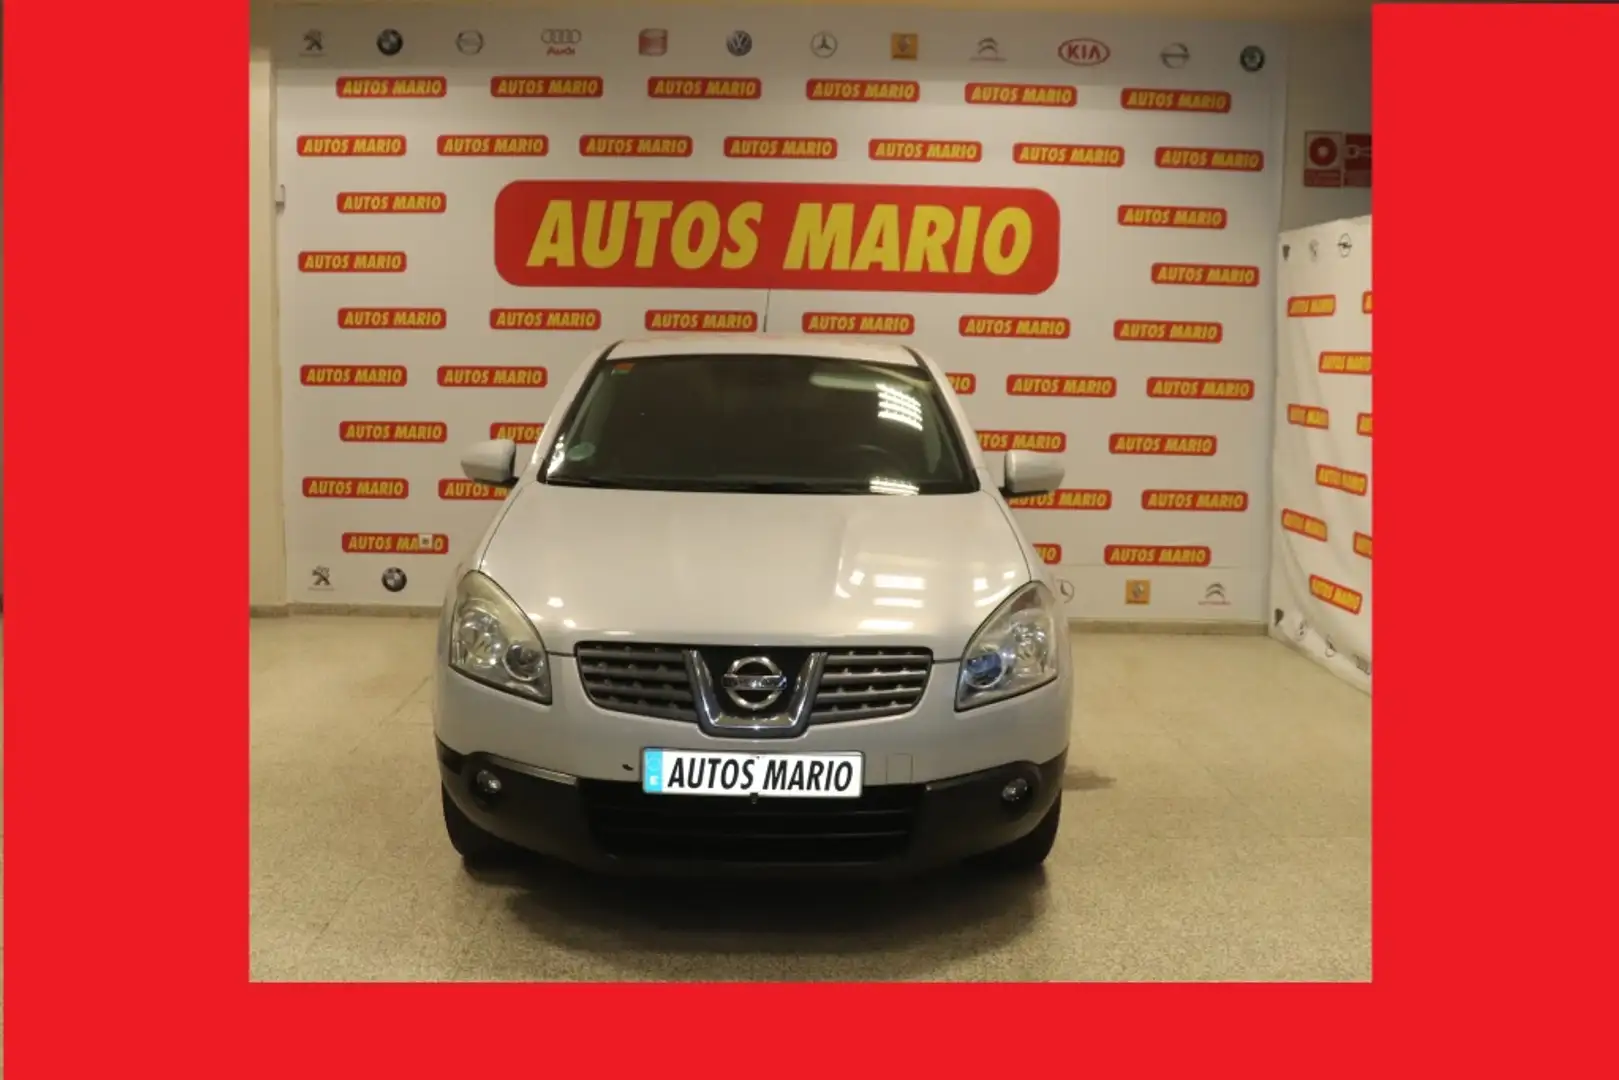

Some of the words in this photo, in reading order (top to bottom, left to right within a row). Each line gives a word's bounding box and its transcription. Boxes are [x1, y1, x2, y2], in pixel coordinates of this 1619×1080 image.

[1066, 43, 1101, 60] KIA
[343, 80, 389, 95] AUTOS
[391, 80, 442, 95] MARIO
[497, 79, 546, 95] AUTOS
[548, 80, 598, 95] MARIO
[654, 80, 702, 95] AUTOS
[705, 81, 756, 96] MARIO
[814, 82, 862, 97] AUTOS
[864, 83, 916, 99] MARIO
[971, 86, 1019, 101] AUTOS
[1021, 88, 1073, 103] MARIO
[1126, 91, 1174, 107] AUTOS
[1176, 93, 1226, 109] MARIO
[303, 138, 350, 153] AUTOS
[352, 138, 402, 153] MARIO
[443, 138, 491, 153] AUTOS
[493, 138, 544, 153] MARIO
[586, 138, 635, 153] AUTOS
[637, 139, 689, 153] MARIO
[731, 140, 779, 155] AUTOS
[781, 141, 833, 156] MARIO
[876, 142, 923, 158] AUTOS
[925, 144, 978, 159] MARIO
[1019, 146, 1066, 162] AUTOS
[1068, 148, 1120, 163] MARIO
[1160, 151, 1209, 166] AUTOS
[1211, 153, 1259, 167] MARIO
[342, 195, 390, 210] AUTOS
[392, 195, 442, 210] MARIO
[1123, 209, 1171, 223] AUTOS
[1174, 210, 1222, 225] MARIO
[527, 199, 764, 269] AUTOS
[783, 202, 1033, 276] MARIO
[304, 254, 351, 269] AUTOS
[353, 254, 402, 269] MARIO
[1157, 266, 1204, 281] AUTOS
[1206, 268, 1255, 283] MARIO
[343, 311, 389, 326] AUTOS
[391, 311, 442, 326] MARIO
[495, 311, 543, 327] AUTOS
[546, 312, 596, 327] MARIO
[651, 313, 700, 328] AUTOS
[702, 314, 753, 329] MARIO
[808, 315, 856, 331] AUTOS
[859, 316, 911, 332] MARIO
[964, 319, 1012, 334] AUTOS
[1014, 320, 1067, 335] MARIO
[1119, 323, 1166, 338] AUTOS
[1169, 325, 1218, 340] MARIO
[306, 368, 352, 383] AUTOS
[354, 368, 403, 383] MARIO
[443, 369, 490, 384] AUTOS
[492, 369, 543, 385] MARIO
[1012, 378, 1059, 393] AUTOS
[1061, 379, 1112, 394] MARIO
[1152, 380, 1199, 395] AUTOS
[1202, 382, 1251, 397] MARIO
[345, 424, 391, 439] AUTOS
[393, 425, 443, 440] MARIO
[1011, 434, 1062, 449] MARIO
[1114, 437, 1162, 451] AUTOS
[1164, 438, 1212, 453] MARIO
[308, 480, 353, 495] AUTOS
[356, 481, 404, 496] MARIO
[445, 482, 491, 497] AUTOS
[1057, 493, 1107, 507] MARIO
[1147, 493, 1194, 508] AUTOS
[1196, 494, 1243, 508] MARIO
[348, 536, 393, 550] AUTOS
[395, 536, 444, 552] MAO
[1109, 548, 1157, 563] AUTOS
[1159, 549, 1206, 563] MARIO
[667, 757, 755, 790] AUTOS
[762, 759, 853, 792] MARIO
